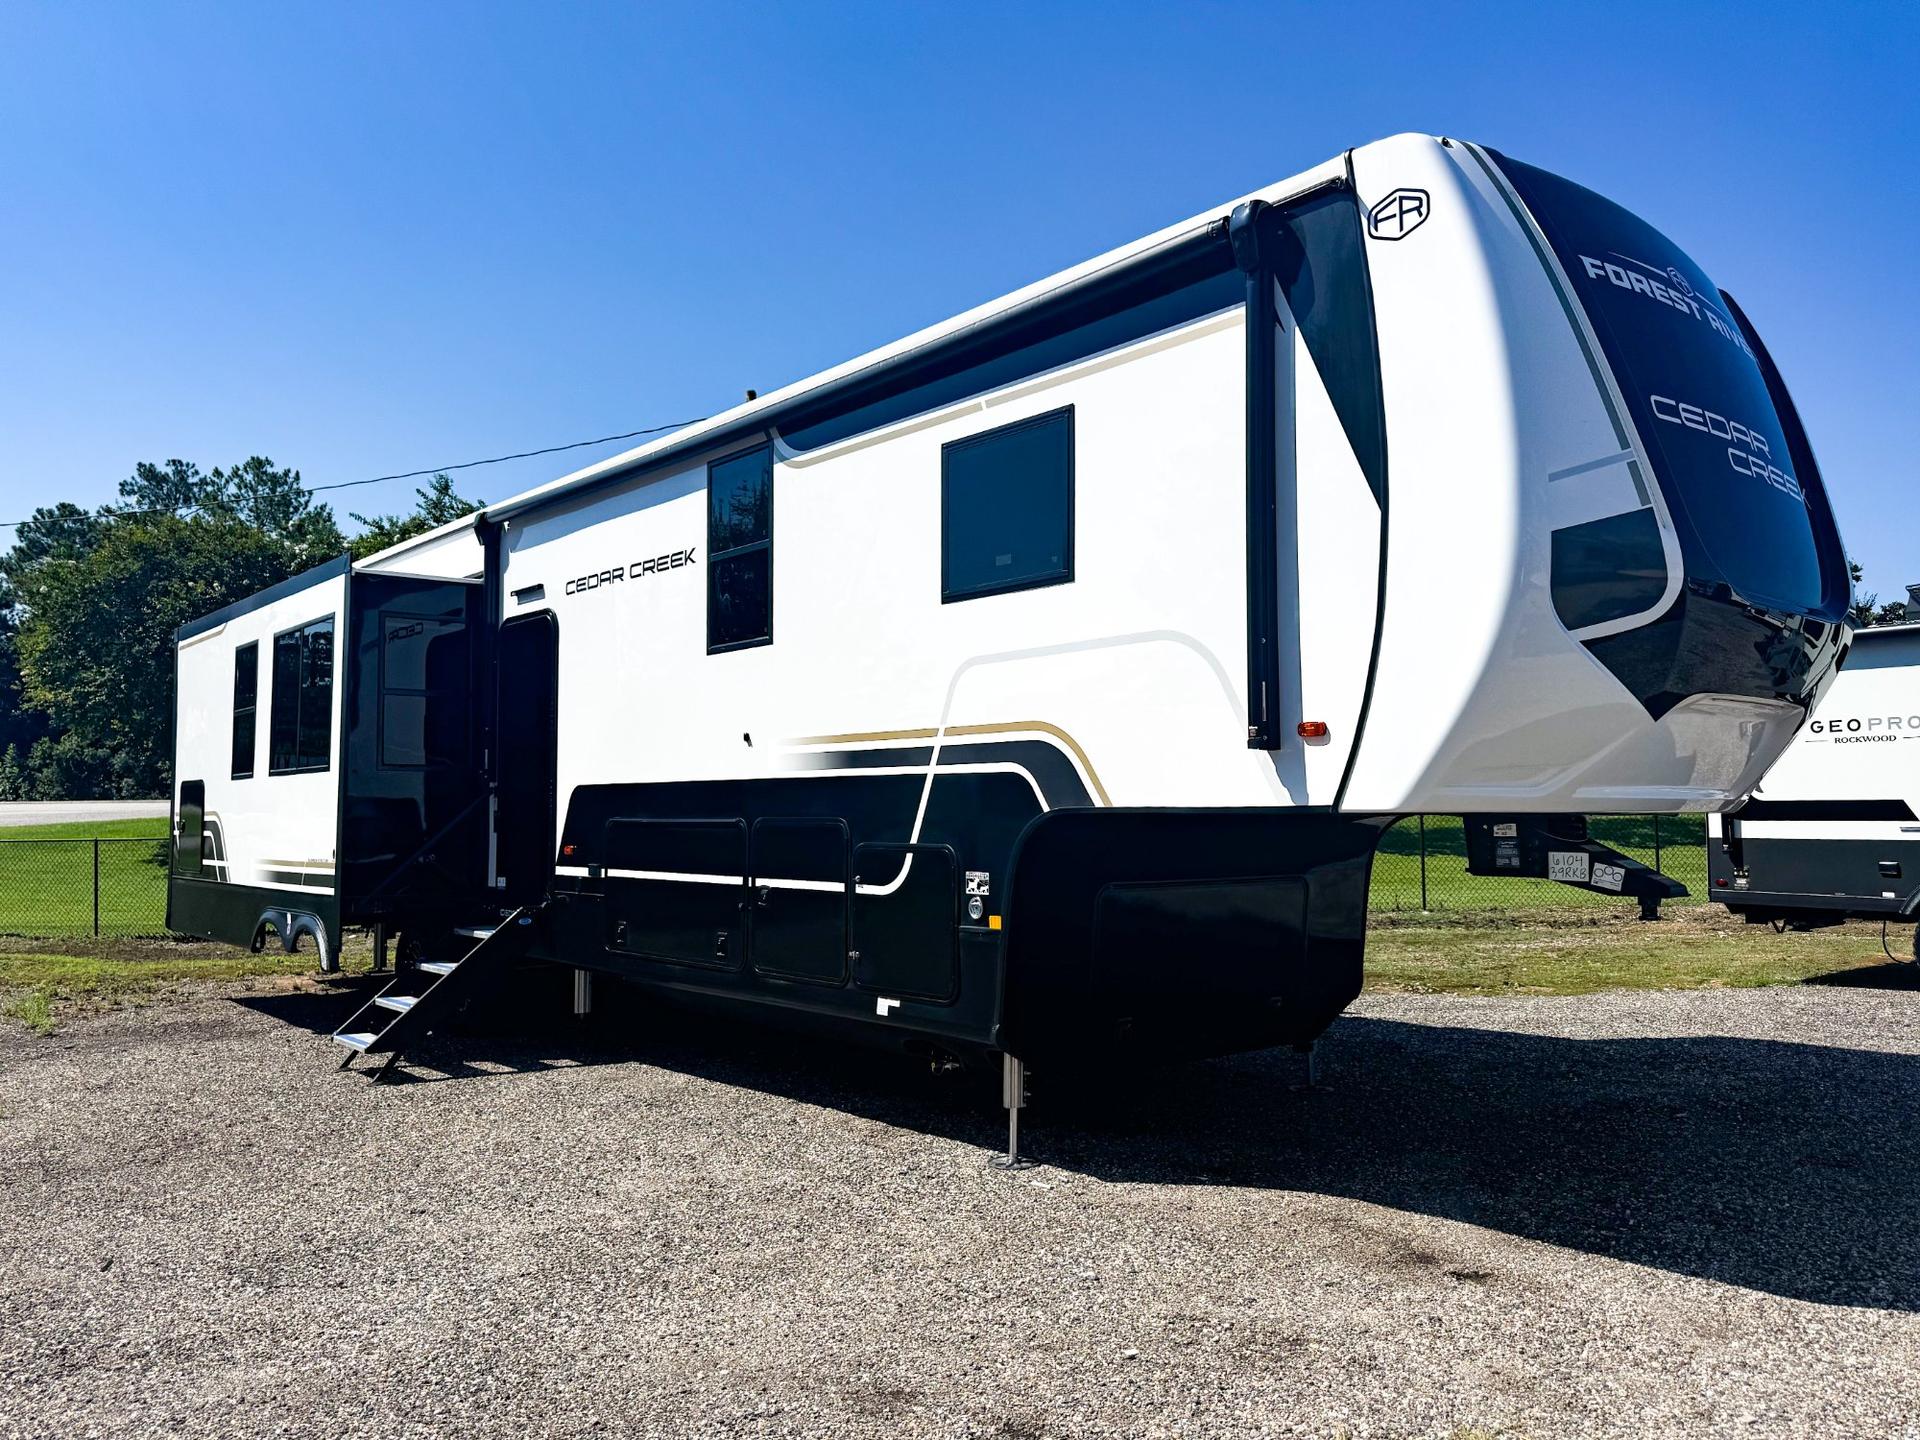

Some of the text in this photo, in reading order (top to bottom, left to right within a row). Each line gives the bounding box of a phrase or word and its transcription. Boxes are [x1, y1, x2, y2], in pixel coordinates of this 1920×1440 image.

[1577, 254, 1763, 369] FOREST RIVE
[1650, 394, 1772, 459] CEDAR
[565, 547, 696, 596] CEDAR CREEK
[1834, 734, 1897, 744] ROCKWOOD
